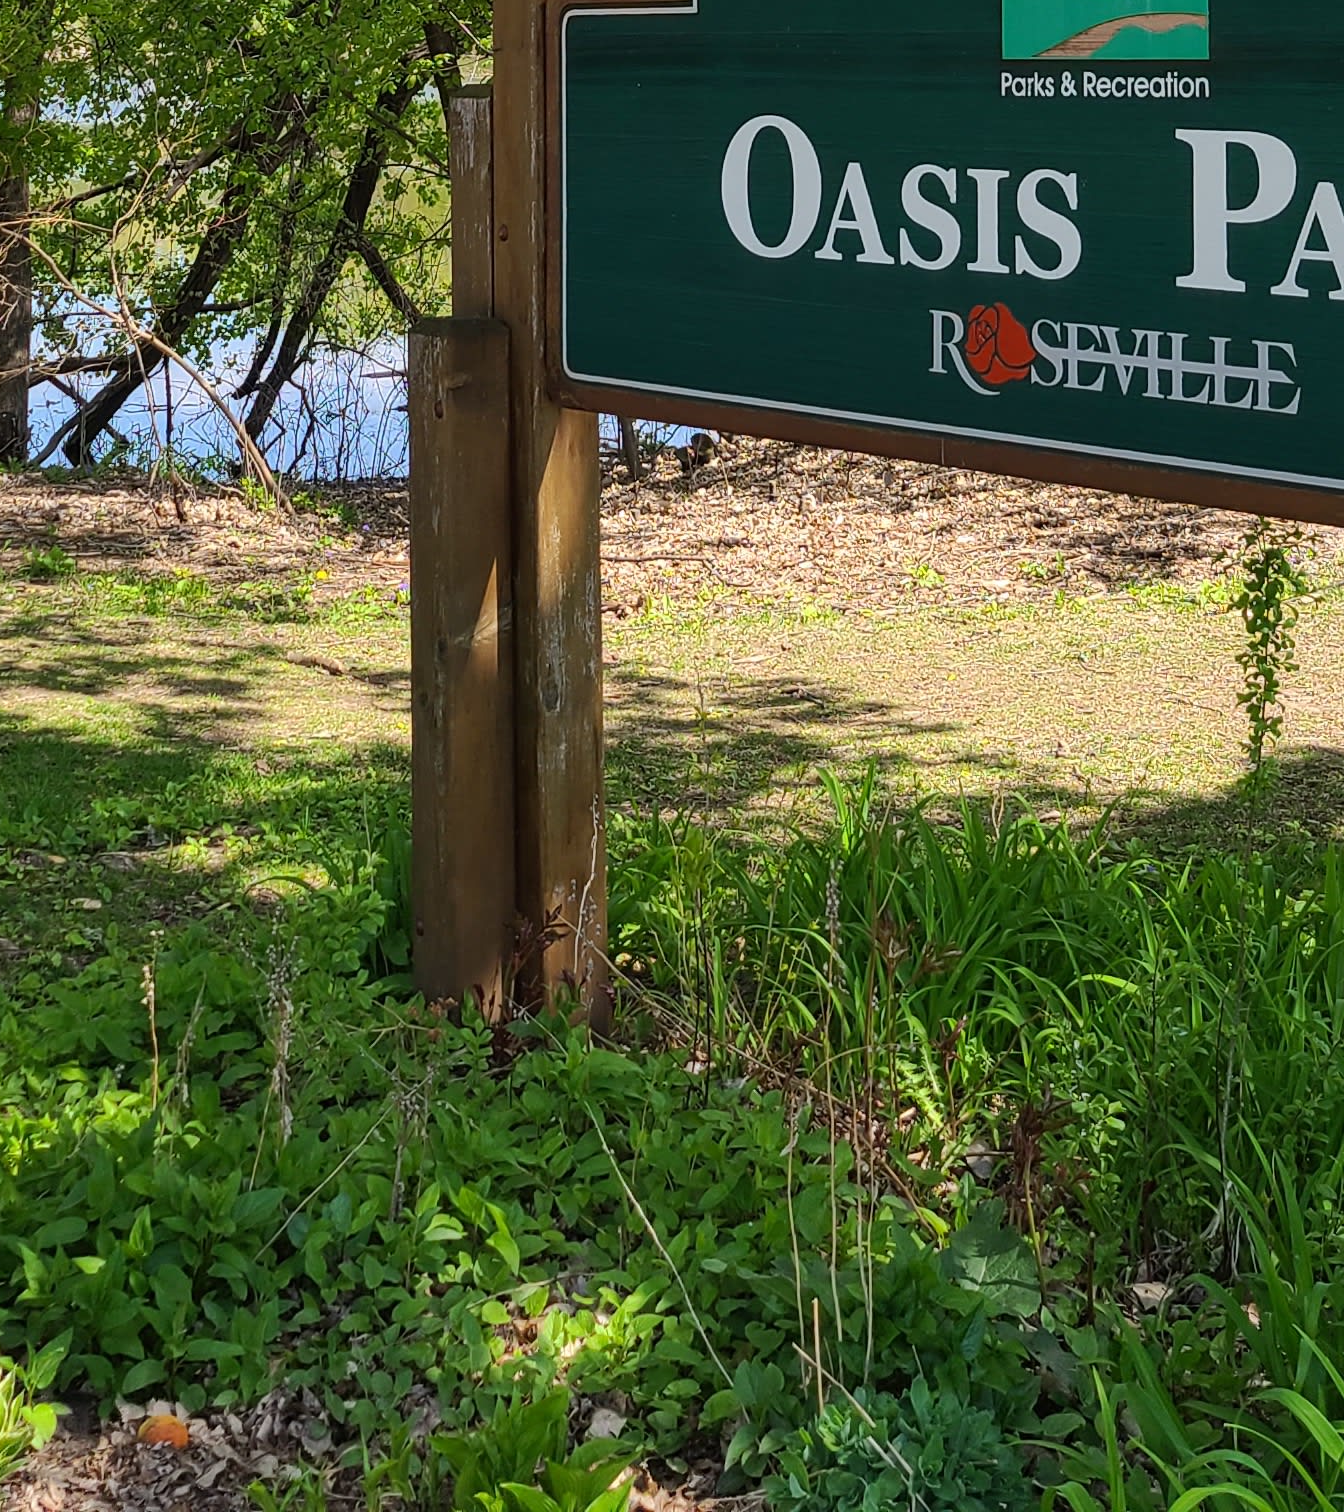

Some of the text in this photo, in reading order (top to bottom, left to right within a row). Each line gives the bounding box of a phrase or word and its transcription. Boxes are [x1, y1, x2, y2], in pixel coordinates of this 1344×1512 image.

[1000, 71, 1210, 98] Parks & Recreation
